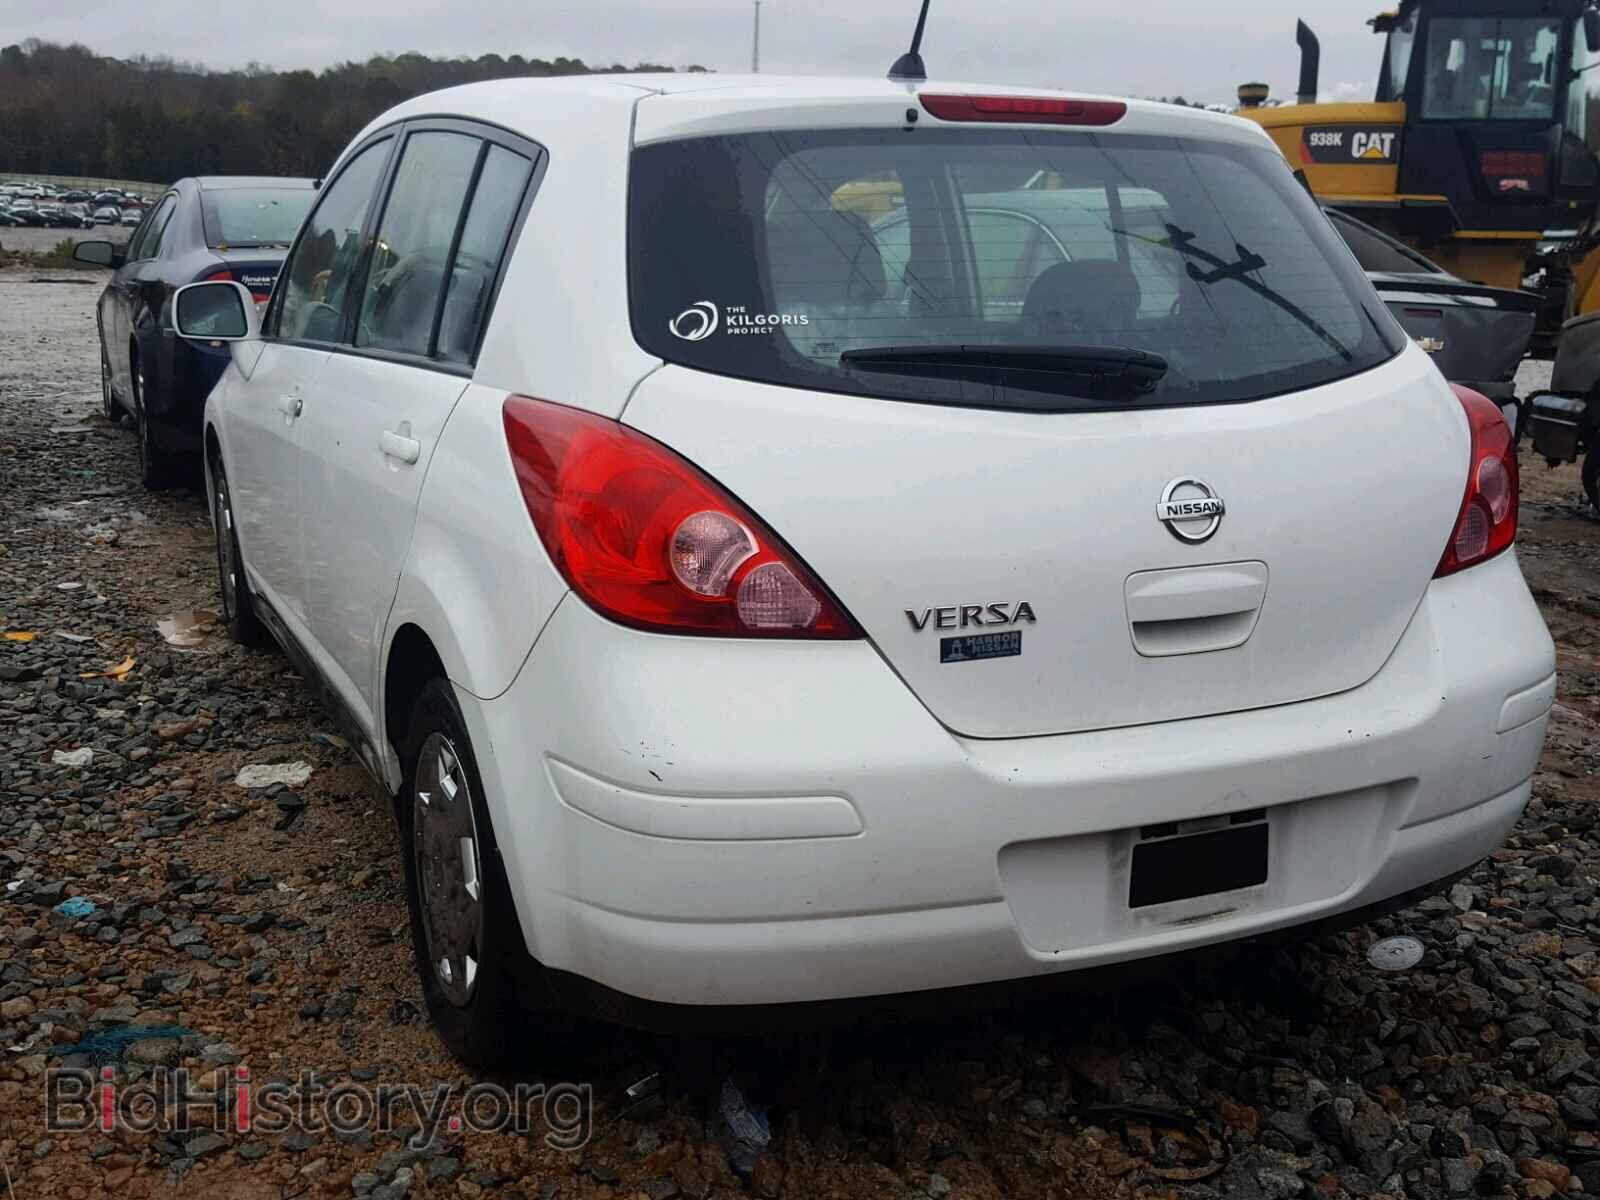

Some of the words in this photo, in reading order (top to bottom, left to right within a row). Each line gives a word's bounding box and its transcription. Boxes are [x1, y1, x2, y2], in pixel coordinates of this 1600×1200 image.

[1310, 132, 1343, 146] 938K
[1351, 132, 1395, 158] CAT
[726, 314, 809, 326] KILGORIS
[727, 327, 773, 335] PROJECT
[1166, 502, 1221, 516] NISSAN
[904, 600, 1037, 632] VERSA
